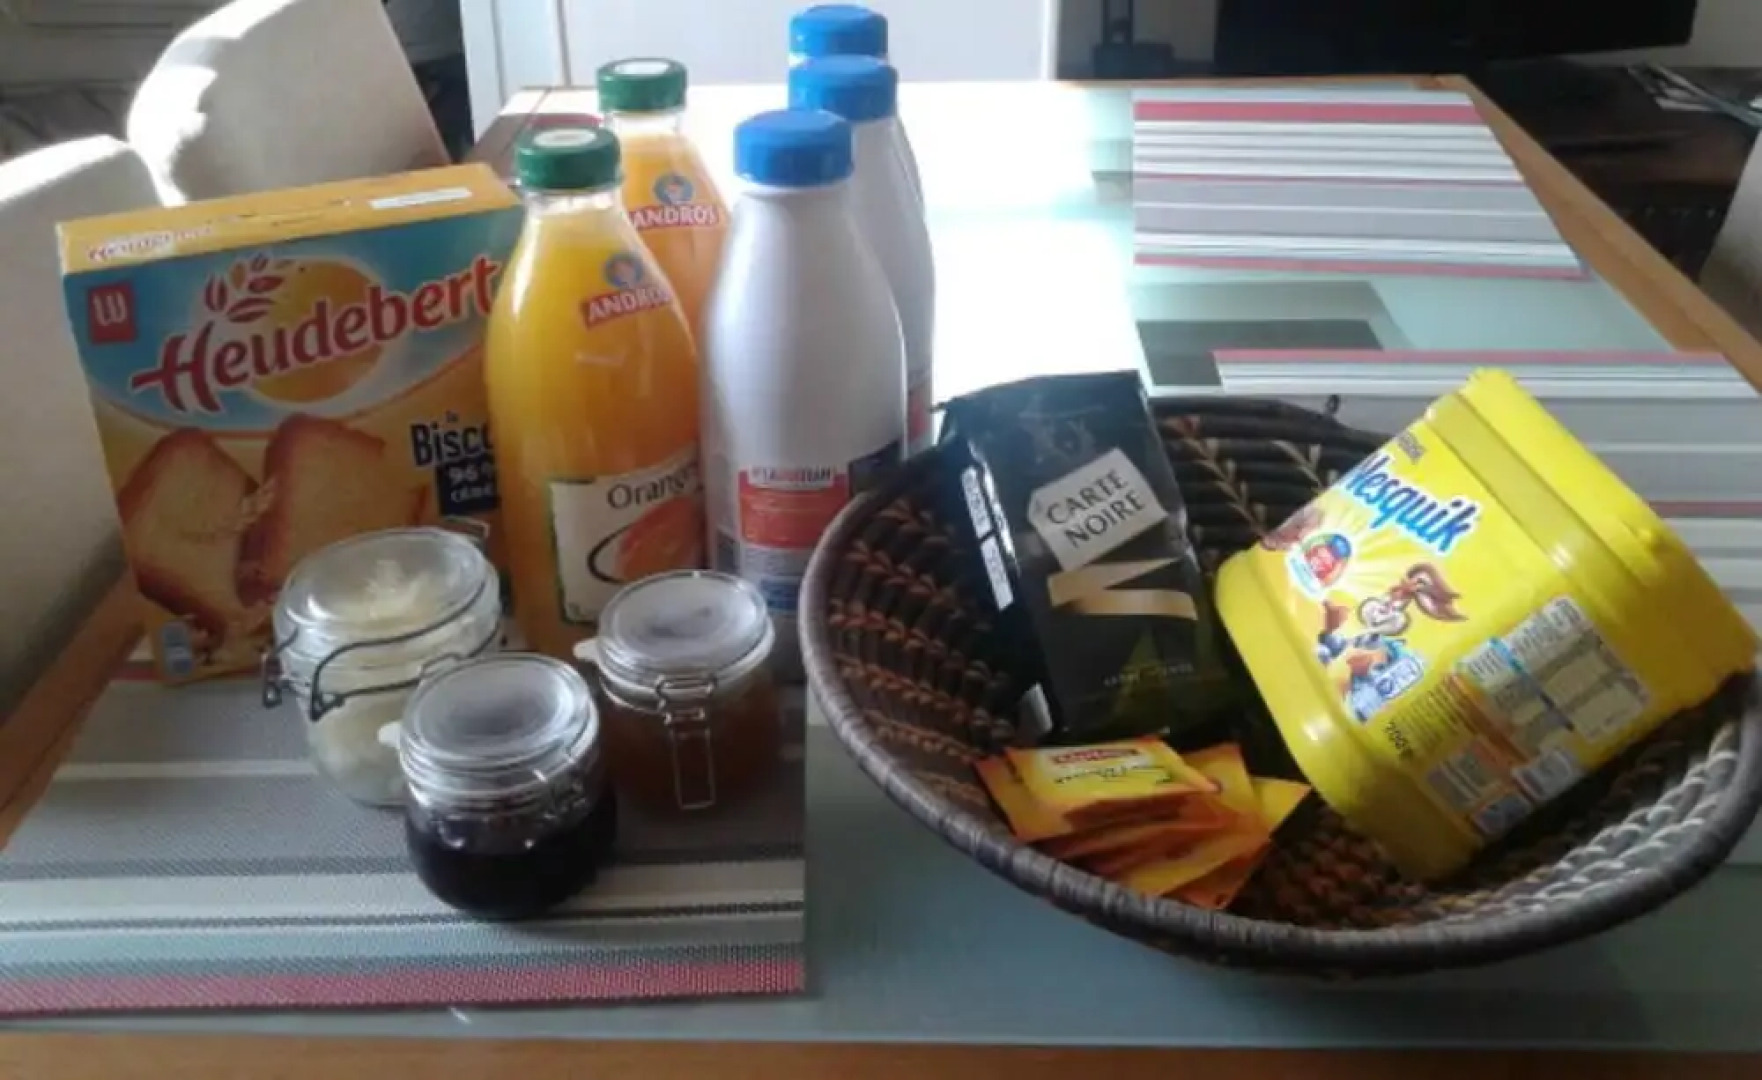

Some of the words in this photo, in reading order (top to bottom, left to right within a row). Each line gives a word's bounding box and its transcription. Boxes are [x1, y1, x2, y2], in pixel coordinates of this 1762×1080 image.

[131, 256, 496, 412] Heudebert
[1046, 468, 1129, 525] CARTE
[1063, 489, 1146, 549] NOIRE
[1345, 453, 1477, 553] Nesquik
